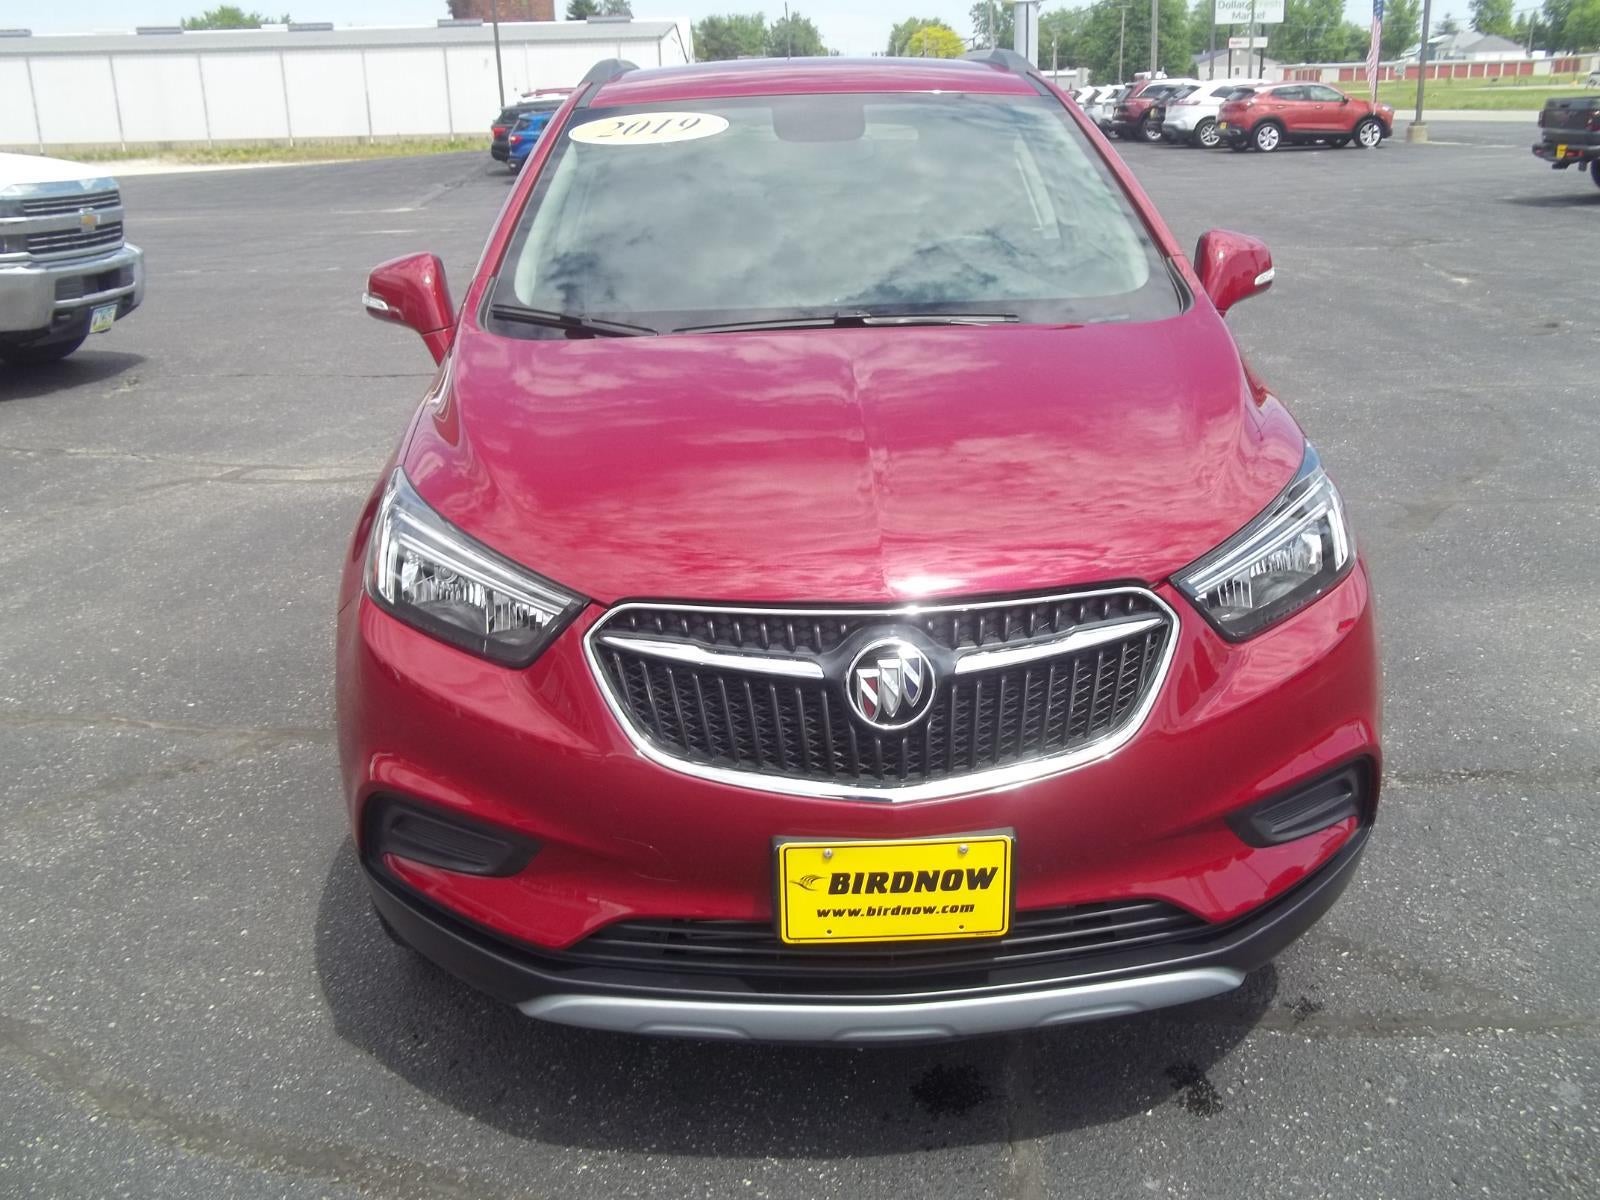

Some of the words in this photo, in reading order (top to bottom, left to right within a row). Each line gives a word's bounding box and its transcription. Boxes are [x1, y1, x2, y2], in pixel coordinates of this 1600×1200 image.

[1232, 10, 1265, 20] Maret
[597, 117, 702, 138] 2019
[828, 866, 999, 895] BIRDNOW
[816, 904, 975, 918] www.birdnow.com
